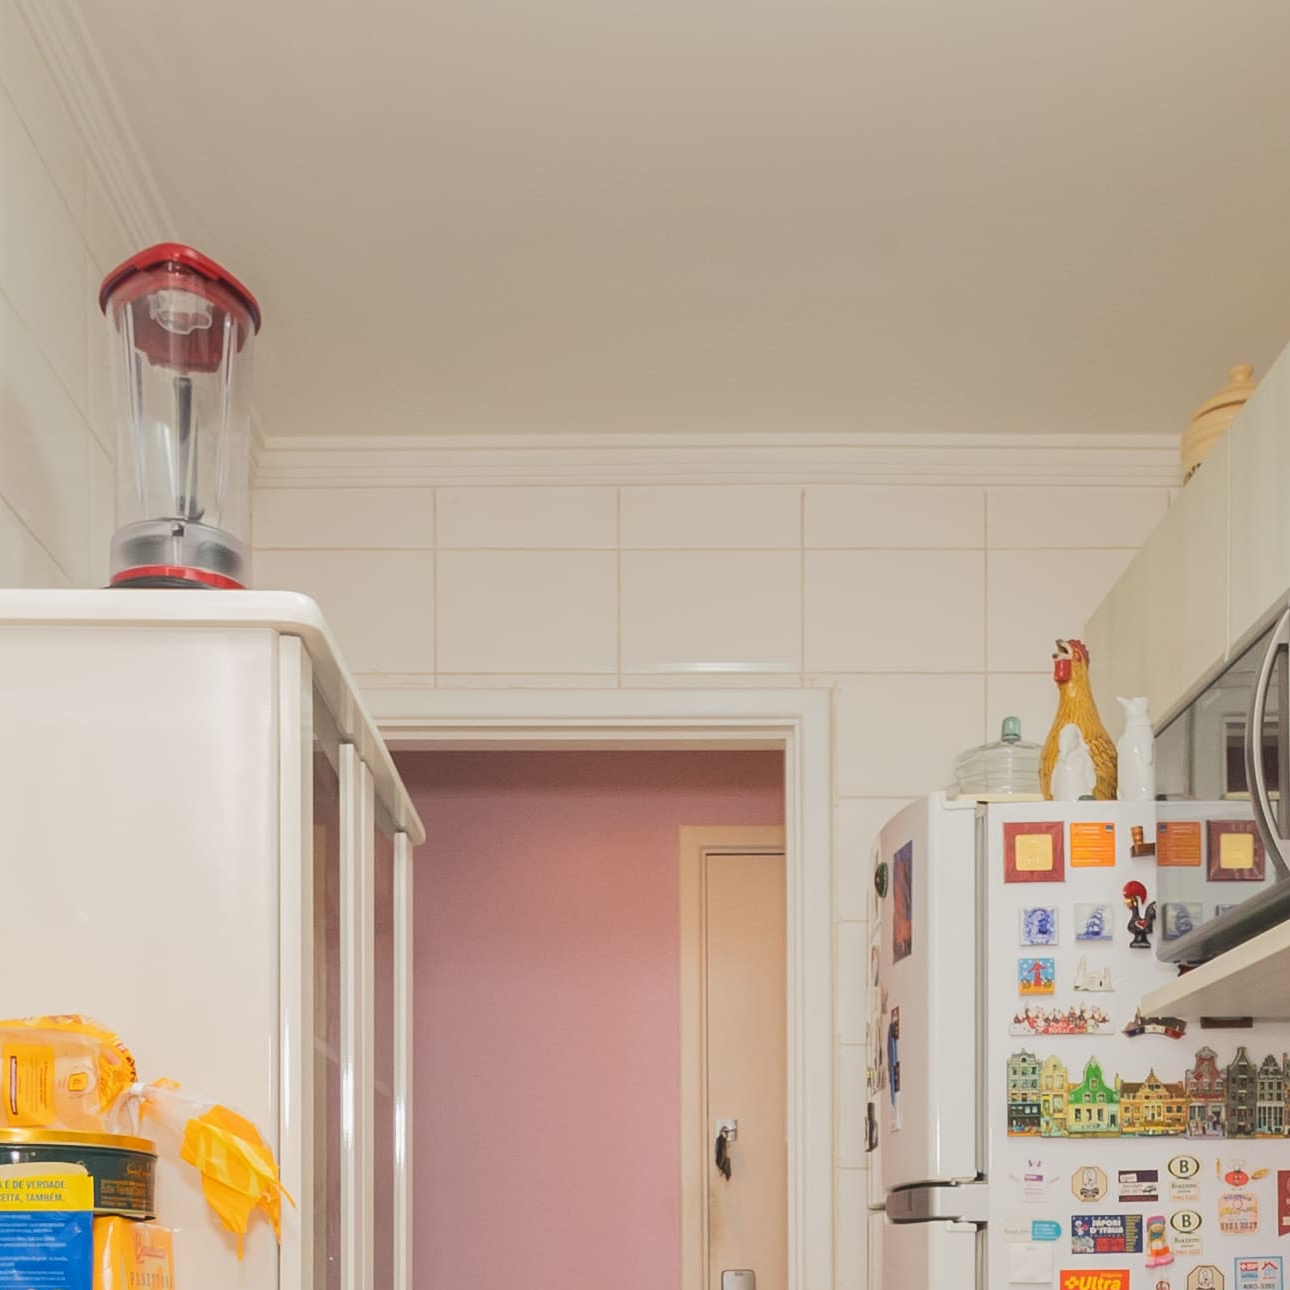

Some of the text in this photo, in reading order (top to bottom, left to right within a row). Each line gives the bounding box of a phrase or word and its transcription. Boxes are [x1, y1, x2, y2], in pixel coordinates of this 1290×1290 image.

[1179, 1159, 1189, 1173] B
[12, 1179, 23, 1188] DE
[1182, 1214, 1192, 1228] B
